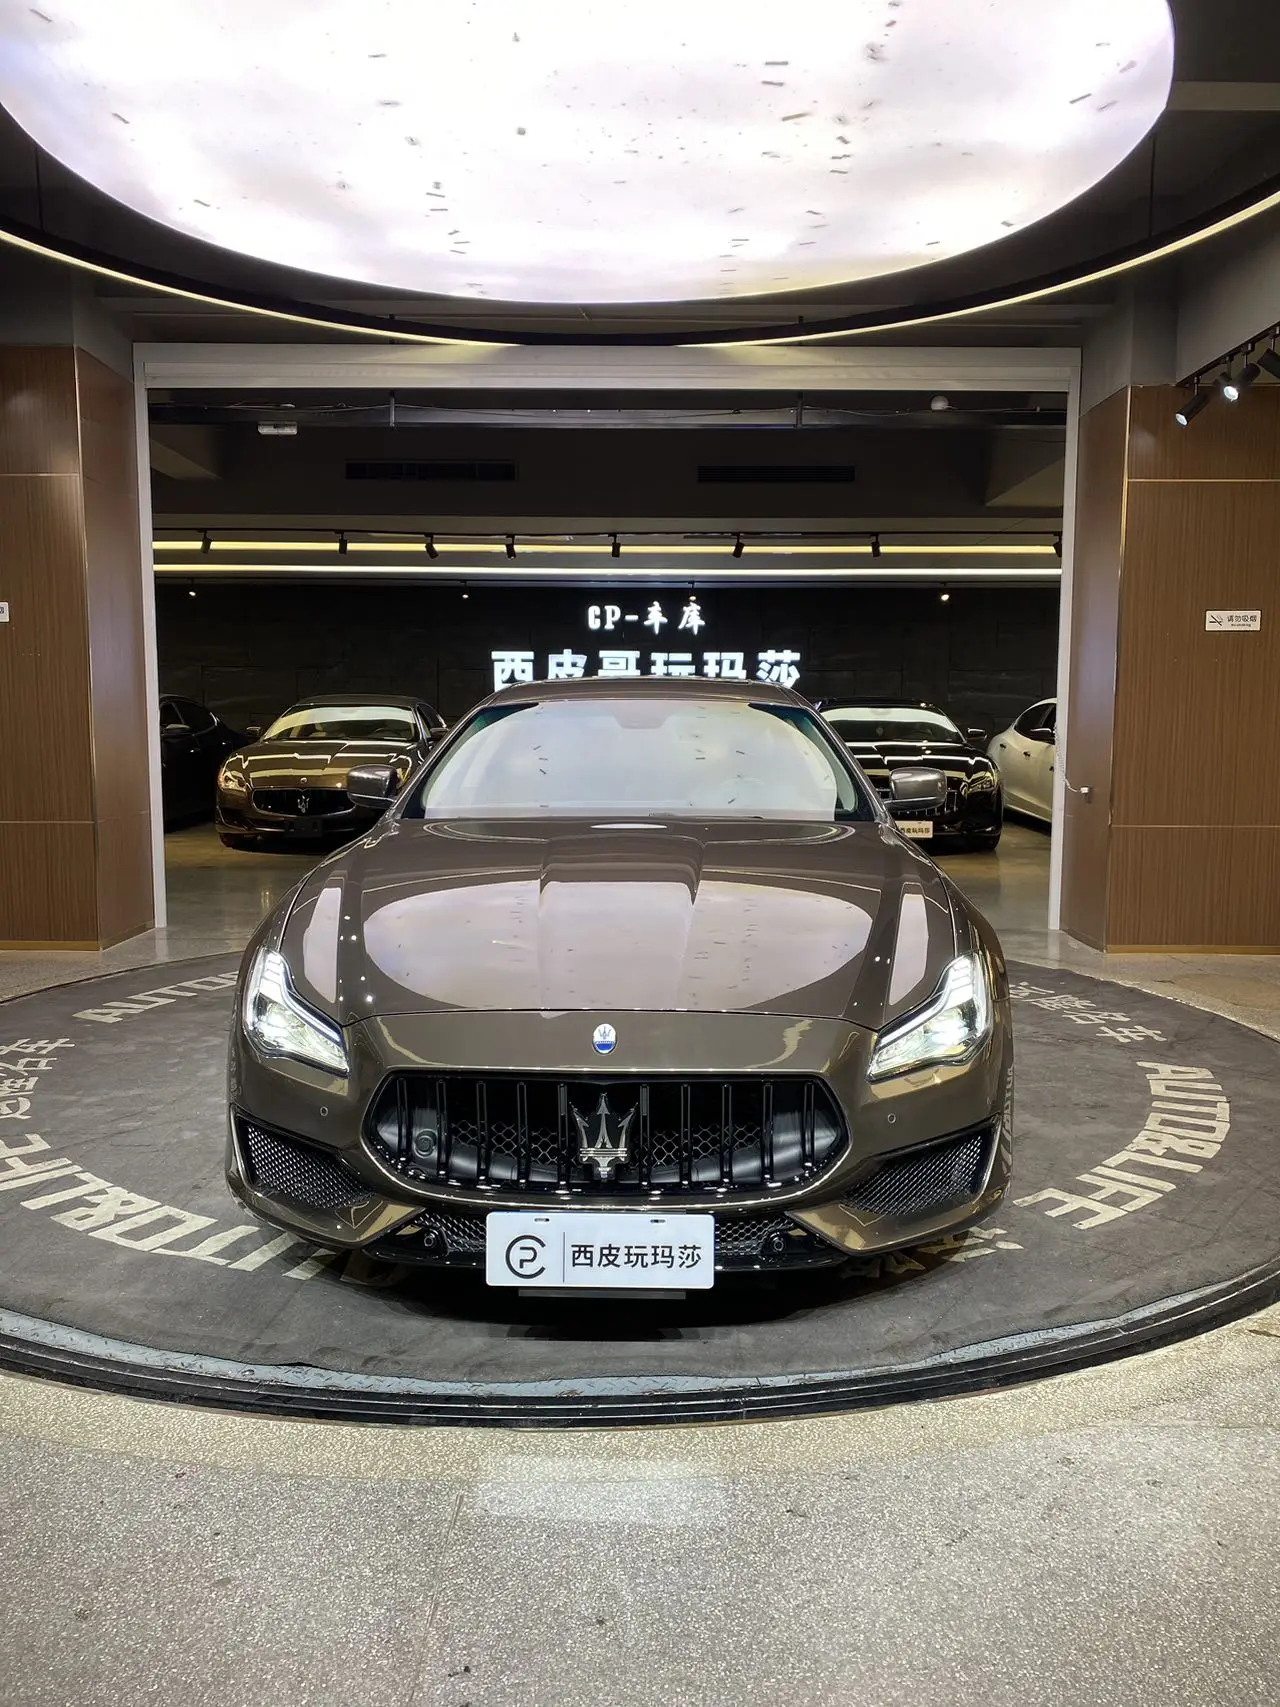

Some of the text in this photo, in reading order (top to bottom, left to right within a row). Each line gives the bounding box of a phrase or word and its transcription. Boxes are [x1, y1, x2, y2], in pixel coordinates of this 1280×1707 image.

[1013, 1061, 1231, 1230] AUTO&LIFE
[571, 1244, 702, 1269] 西皮玩玛莎
